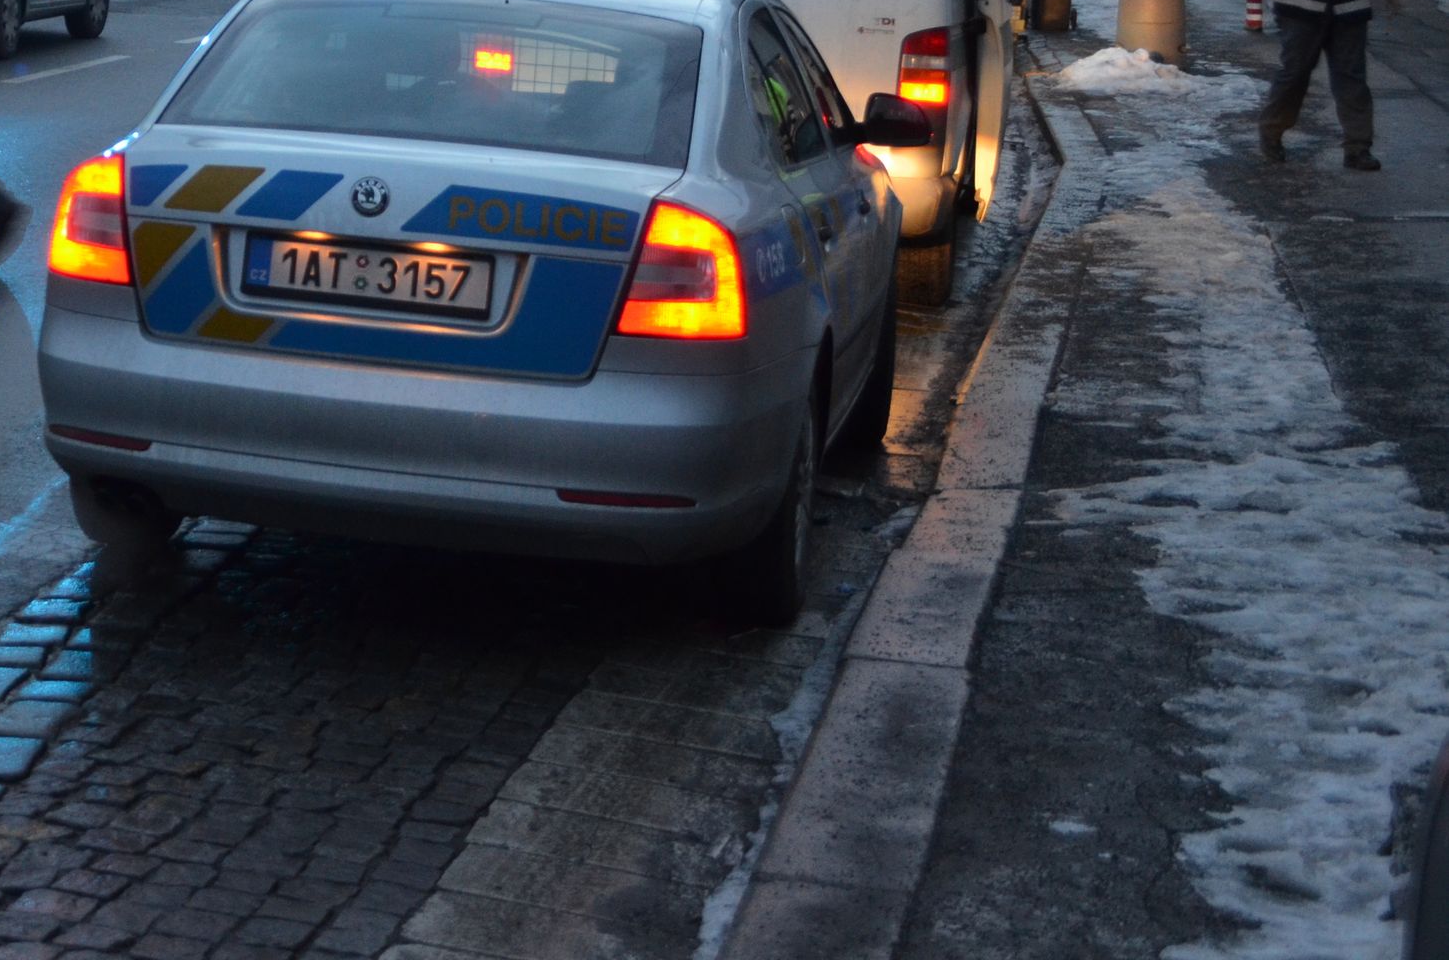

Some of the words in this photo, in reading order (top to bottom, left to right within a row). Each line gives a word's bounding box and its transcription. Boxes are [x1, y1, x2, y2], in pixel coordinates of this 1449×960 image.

[449, 195, 630, 246] POLICIE
[250, 267, 268, 281] CZ
[282, 247, 348, 290] 1AT
[376, 256, 472, 302] 3157
